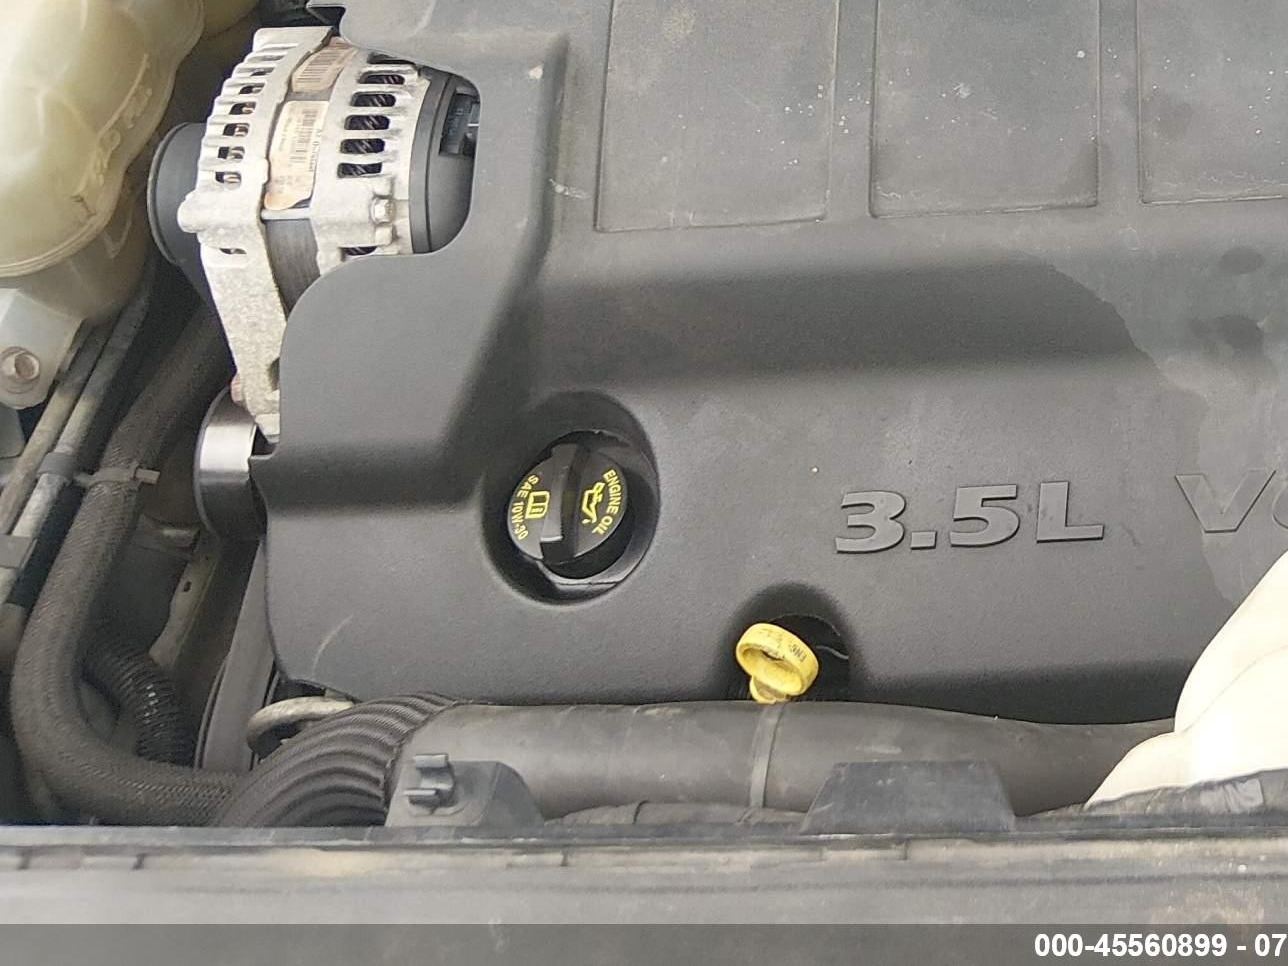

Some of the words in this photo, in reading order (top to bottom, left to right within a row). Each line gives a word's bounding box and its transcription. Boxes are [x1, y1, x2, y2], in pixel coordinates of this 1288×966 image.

[516, 474, 540, 498] SAE
[603, 469, 622, 515] ENGINE
[511, 501, 529, 540] 10W-30
[592, 515, 613, 535] OIL
[835, 481, 1106, 554] 3.5L
